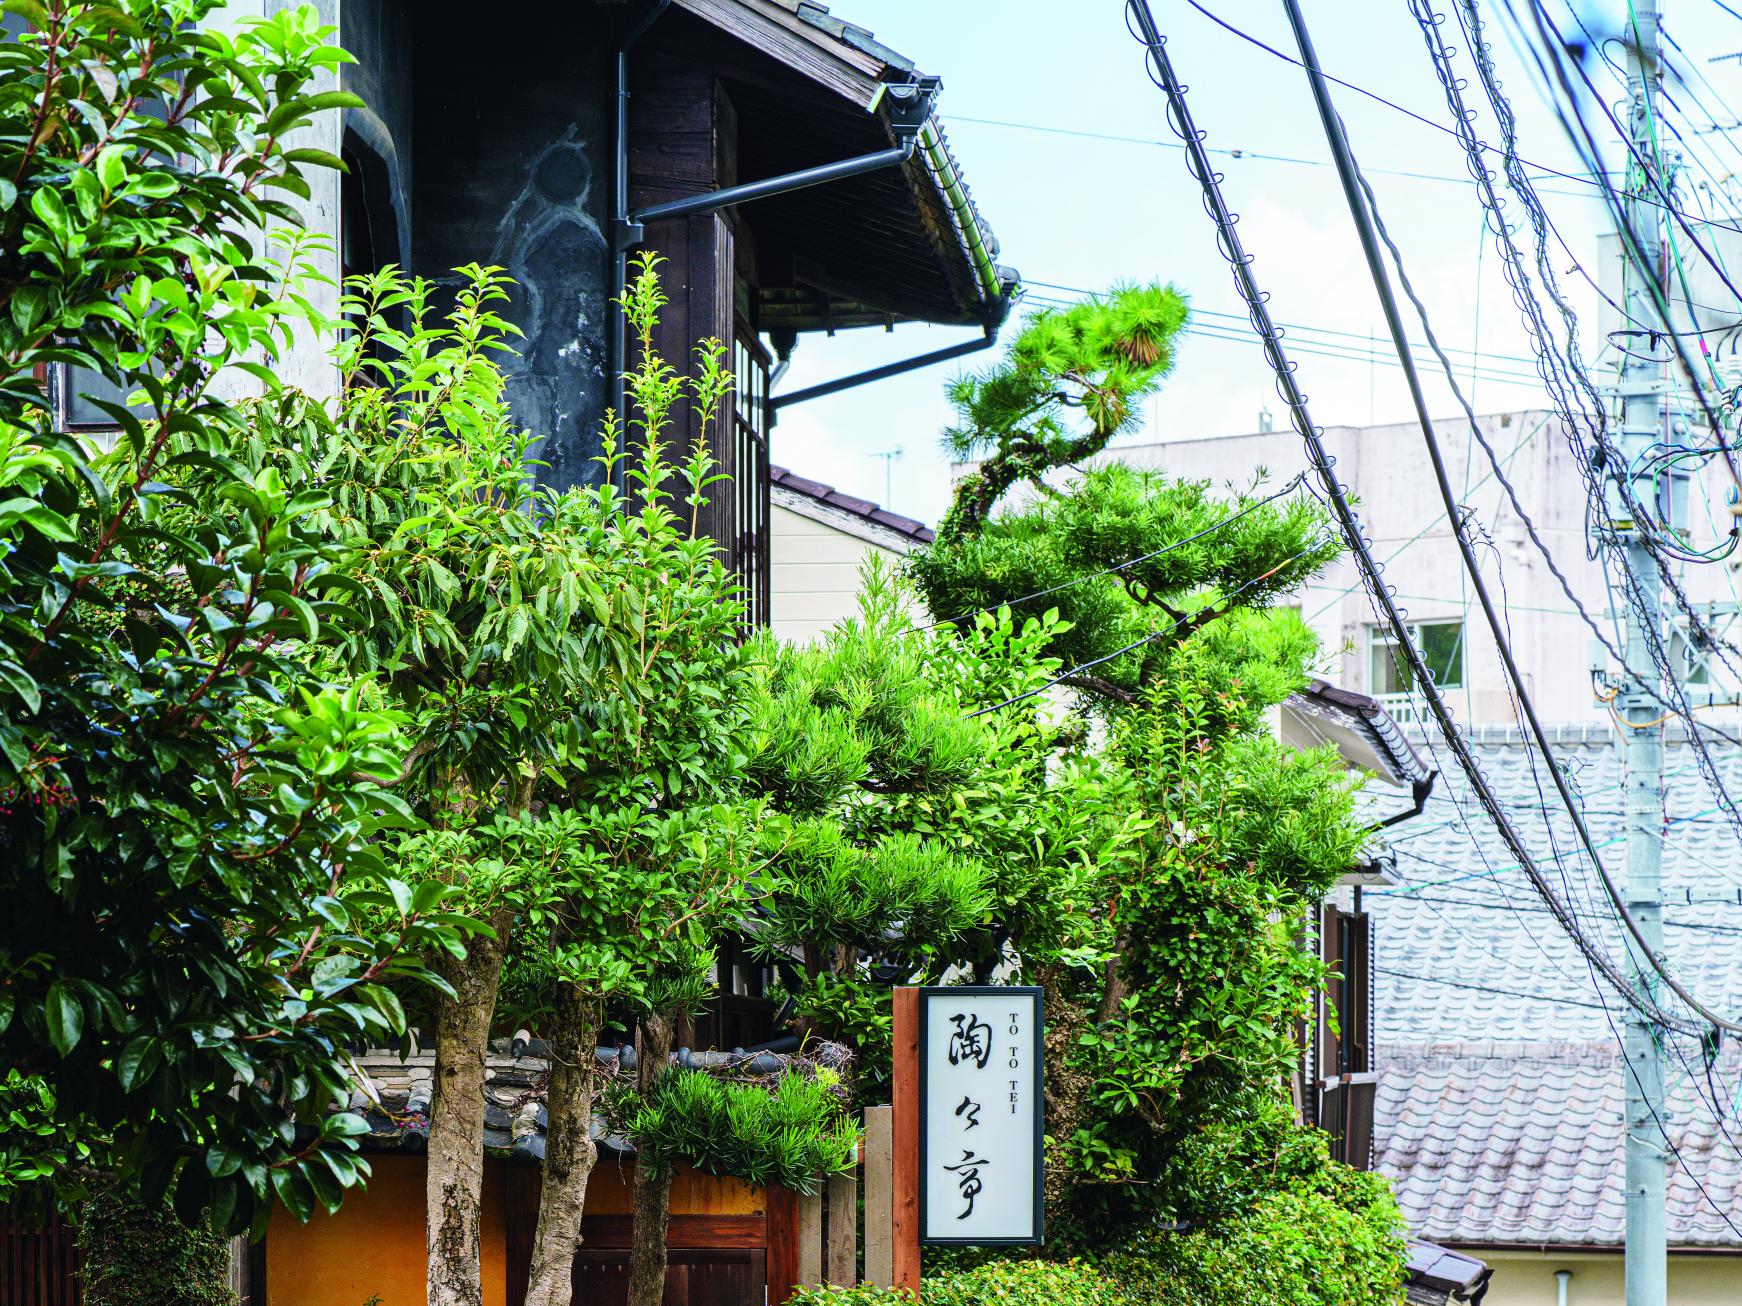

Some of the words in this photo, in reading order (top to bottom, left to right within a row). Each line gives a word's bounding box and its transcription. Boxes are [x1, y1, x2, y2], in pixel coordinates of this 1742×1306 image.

[1008, 1012, 1019, 1036] TO
[1008, 1046, 1019, 1069] TO
[1008, 1080, 1019, 1114] TEI
[942, 1012, 993, 1220] 陶々亭
